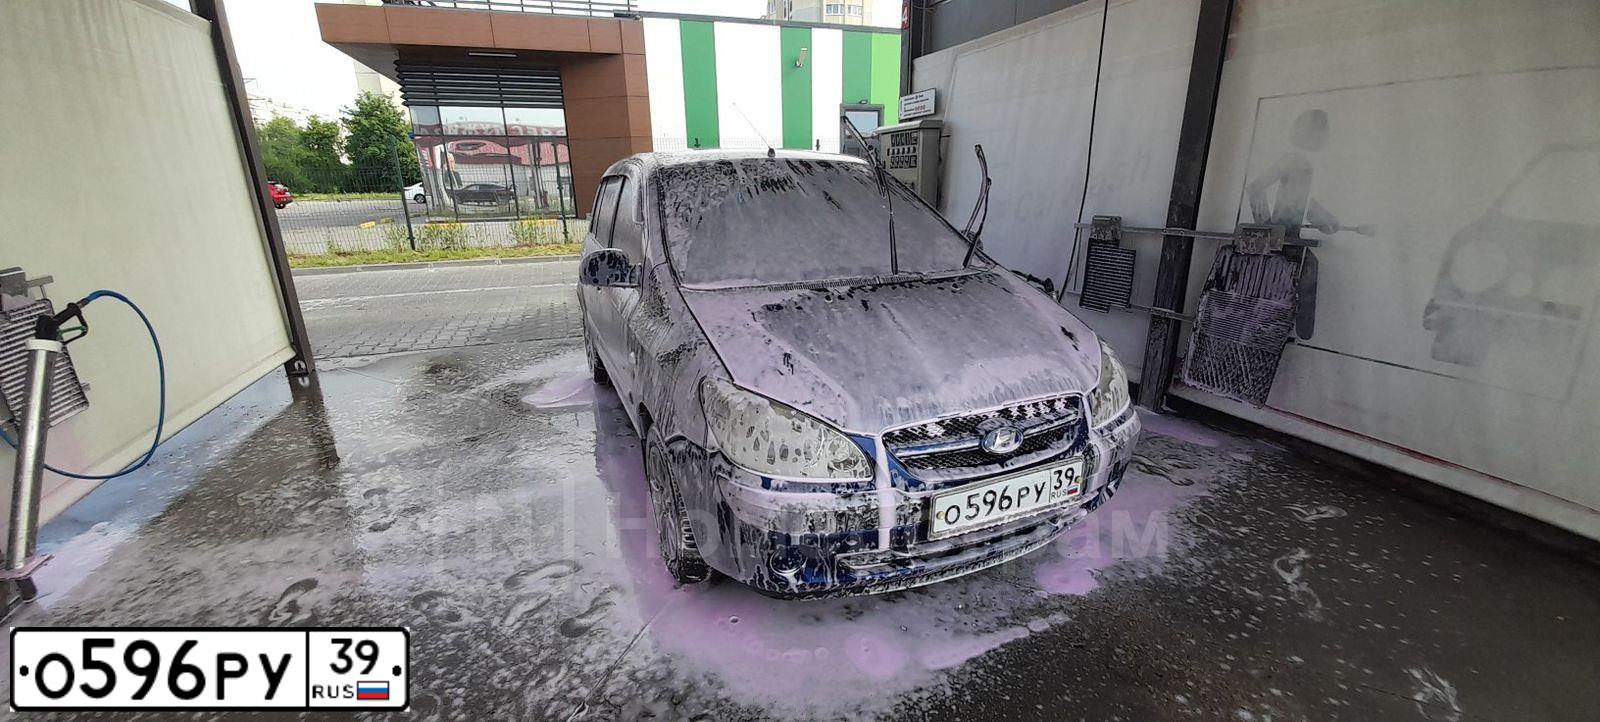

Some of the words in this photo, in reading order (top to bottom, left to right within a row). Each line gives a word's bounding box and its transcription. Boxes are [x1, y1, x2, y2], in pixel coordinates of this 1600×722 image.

[944, 481, 1047, 526] О596РУ
[1053, 467, 1076, 491] 39
[1051, 488, 1067, 501] RUS
